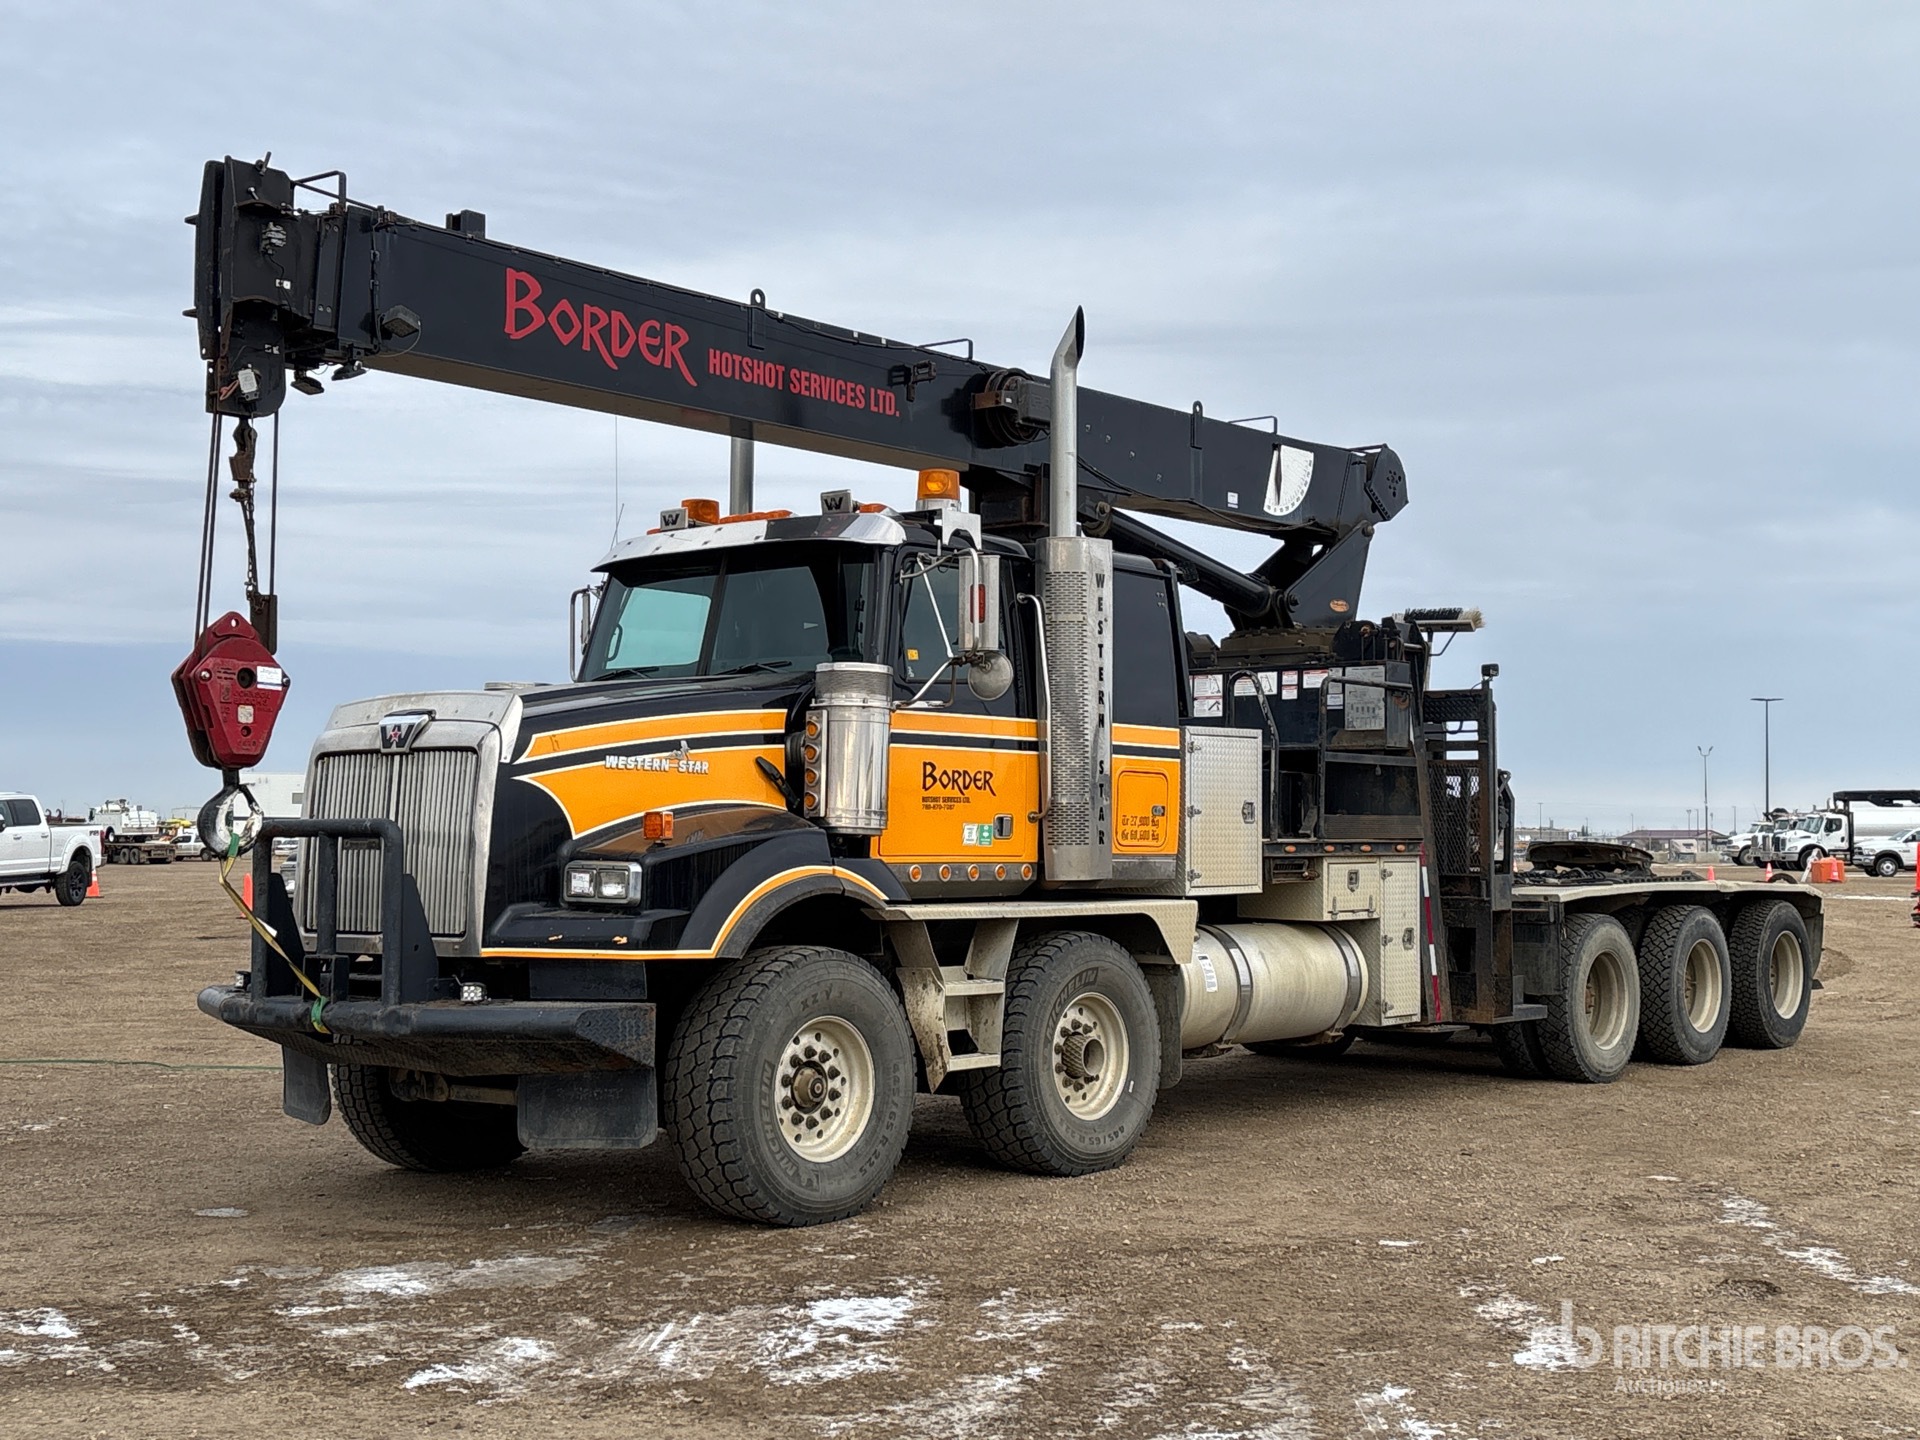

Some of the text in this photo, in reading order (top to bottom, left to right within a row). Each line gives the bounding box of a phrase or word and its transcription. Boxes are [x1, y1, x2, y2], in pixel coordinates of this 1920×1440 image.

[504, 267, 698, 387] BORDER
[708, 348, 901, 418] HOTSHOT SERVICES LTD.
[1095, 573, 1106, 846] WESTERN STAR
[604, 755, 709, 774] WESTERN STAR
[922, 761, 997, 796] BORDER
[1046, 969, 1098, 1041] MICHELIN
[760, 1062, 798, 1177] MICHELIN
